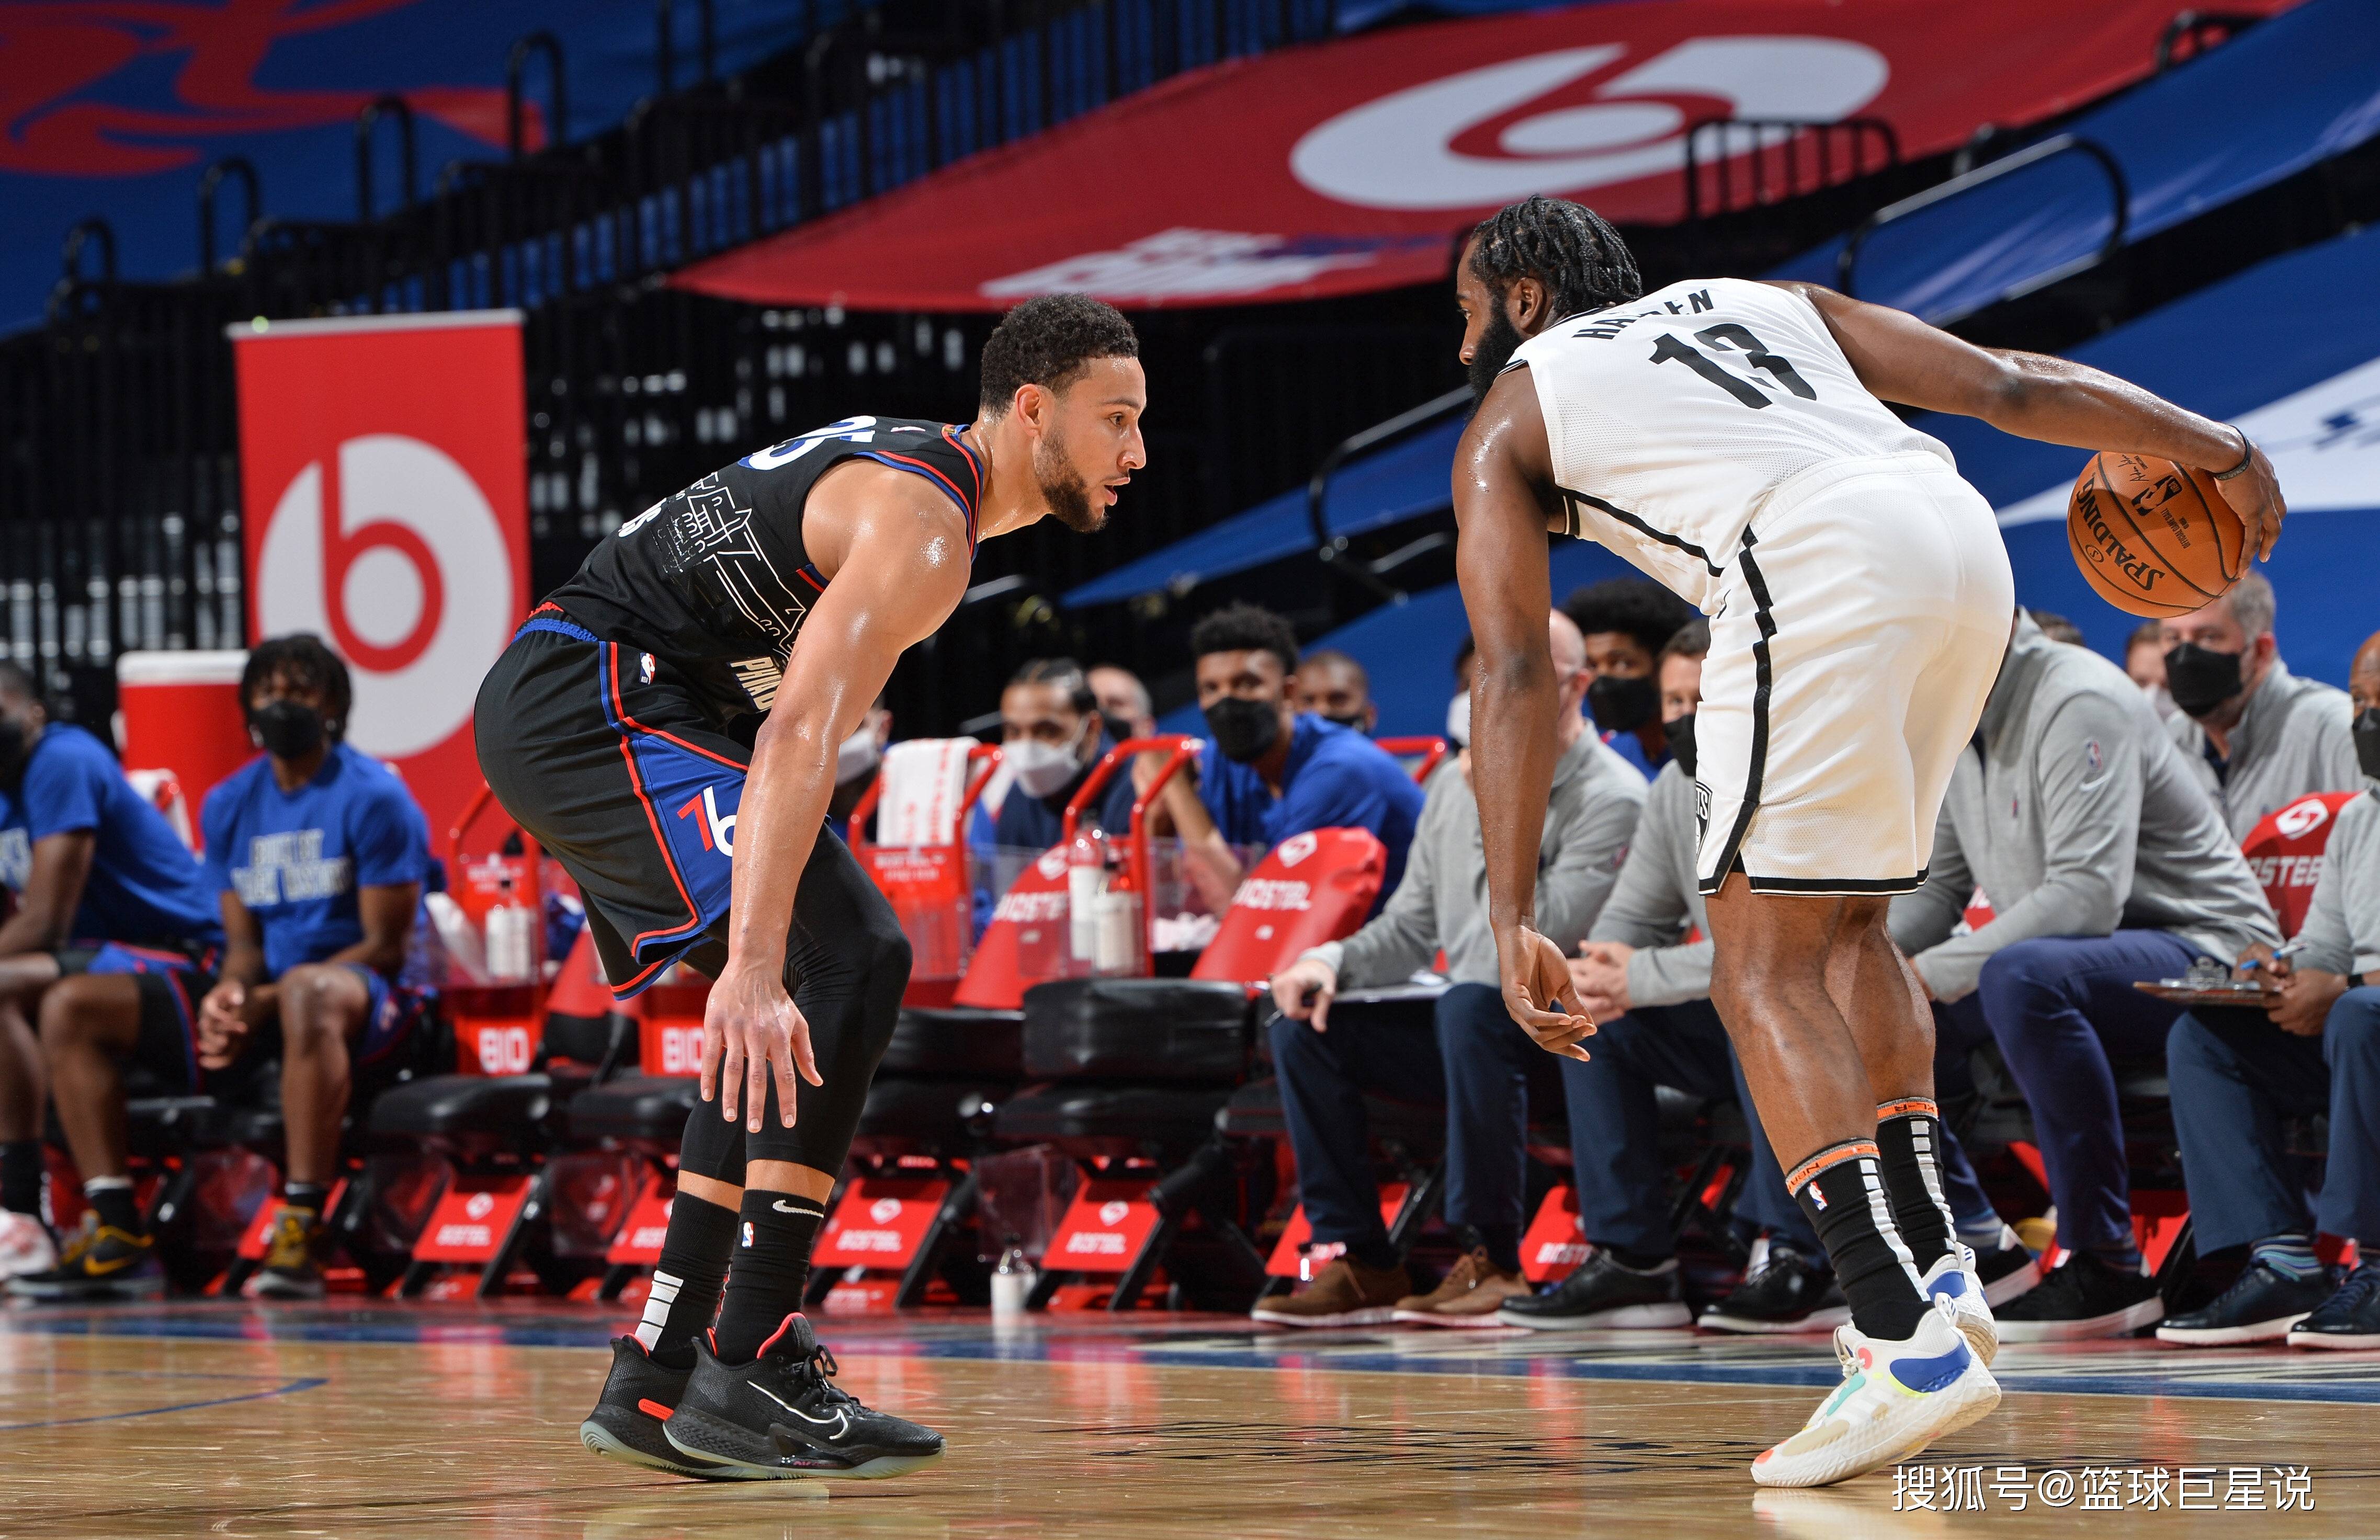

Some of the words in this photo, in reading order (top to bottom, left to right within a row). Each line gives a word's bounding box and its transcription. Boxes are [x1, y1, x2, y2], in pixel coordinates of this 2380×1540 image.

[1649, 323, 1816, 409] 13
[2076, 477, 2166, 590] SPALDING
[2160, 507, 2173, 521] BALL
[2174, 529, 2191, 549] OFFICIAL
[677, 786, 737, 857] 76
